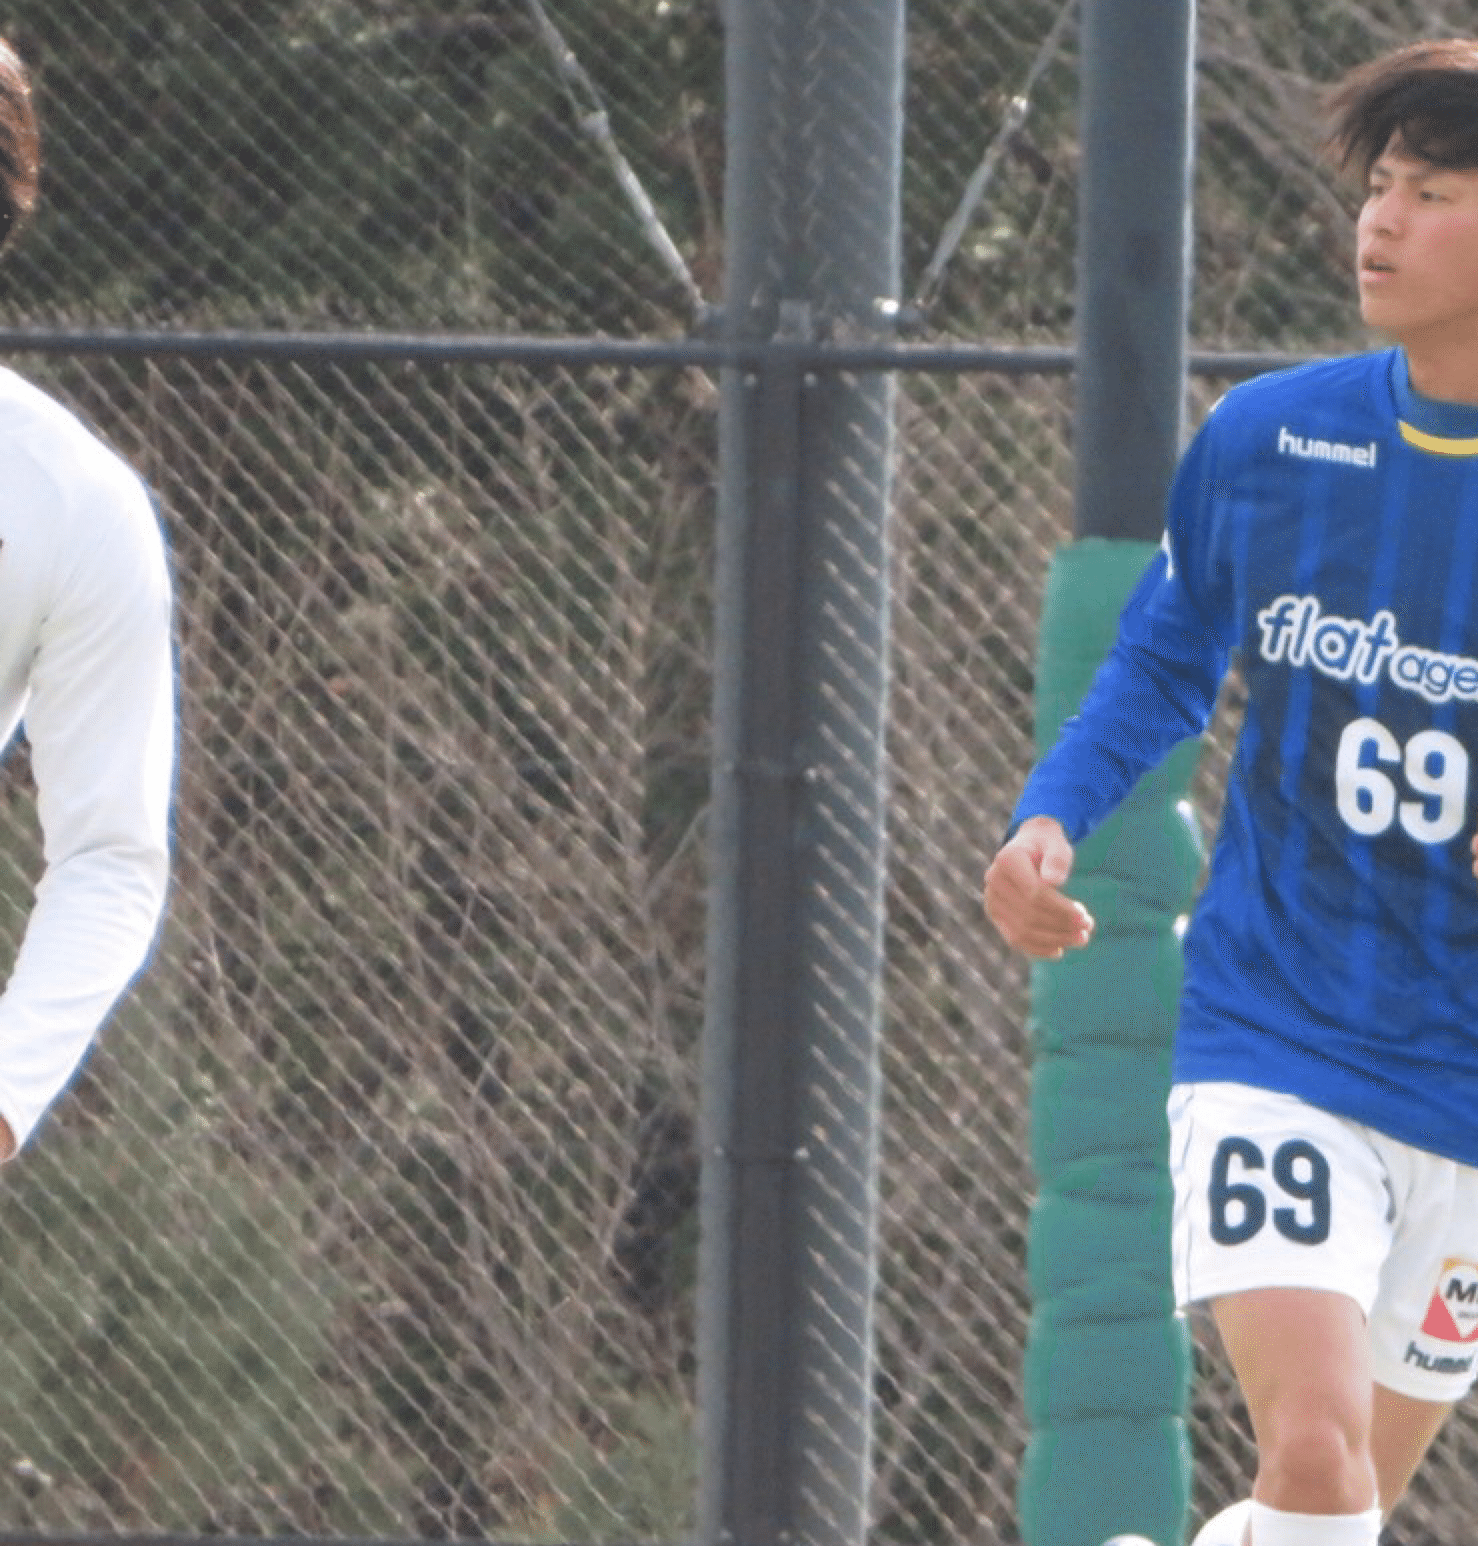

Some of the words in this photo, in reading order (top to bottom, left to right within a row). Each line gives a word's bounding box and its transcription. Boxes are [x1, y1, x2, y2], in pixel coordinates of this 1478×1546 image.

[1278, 425, 1377, 469] hummel
[1258, 596, 1396, 685] flat
[1335, 717, 1470, 844] 69
[1208, 1135, 1332, 1246] 69
